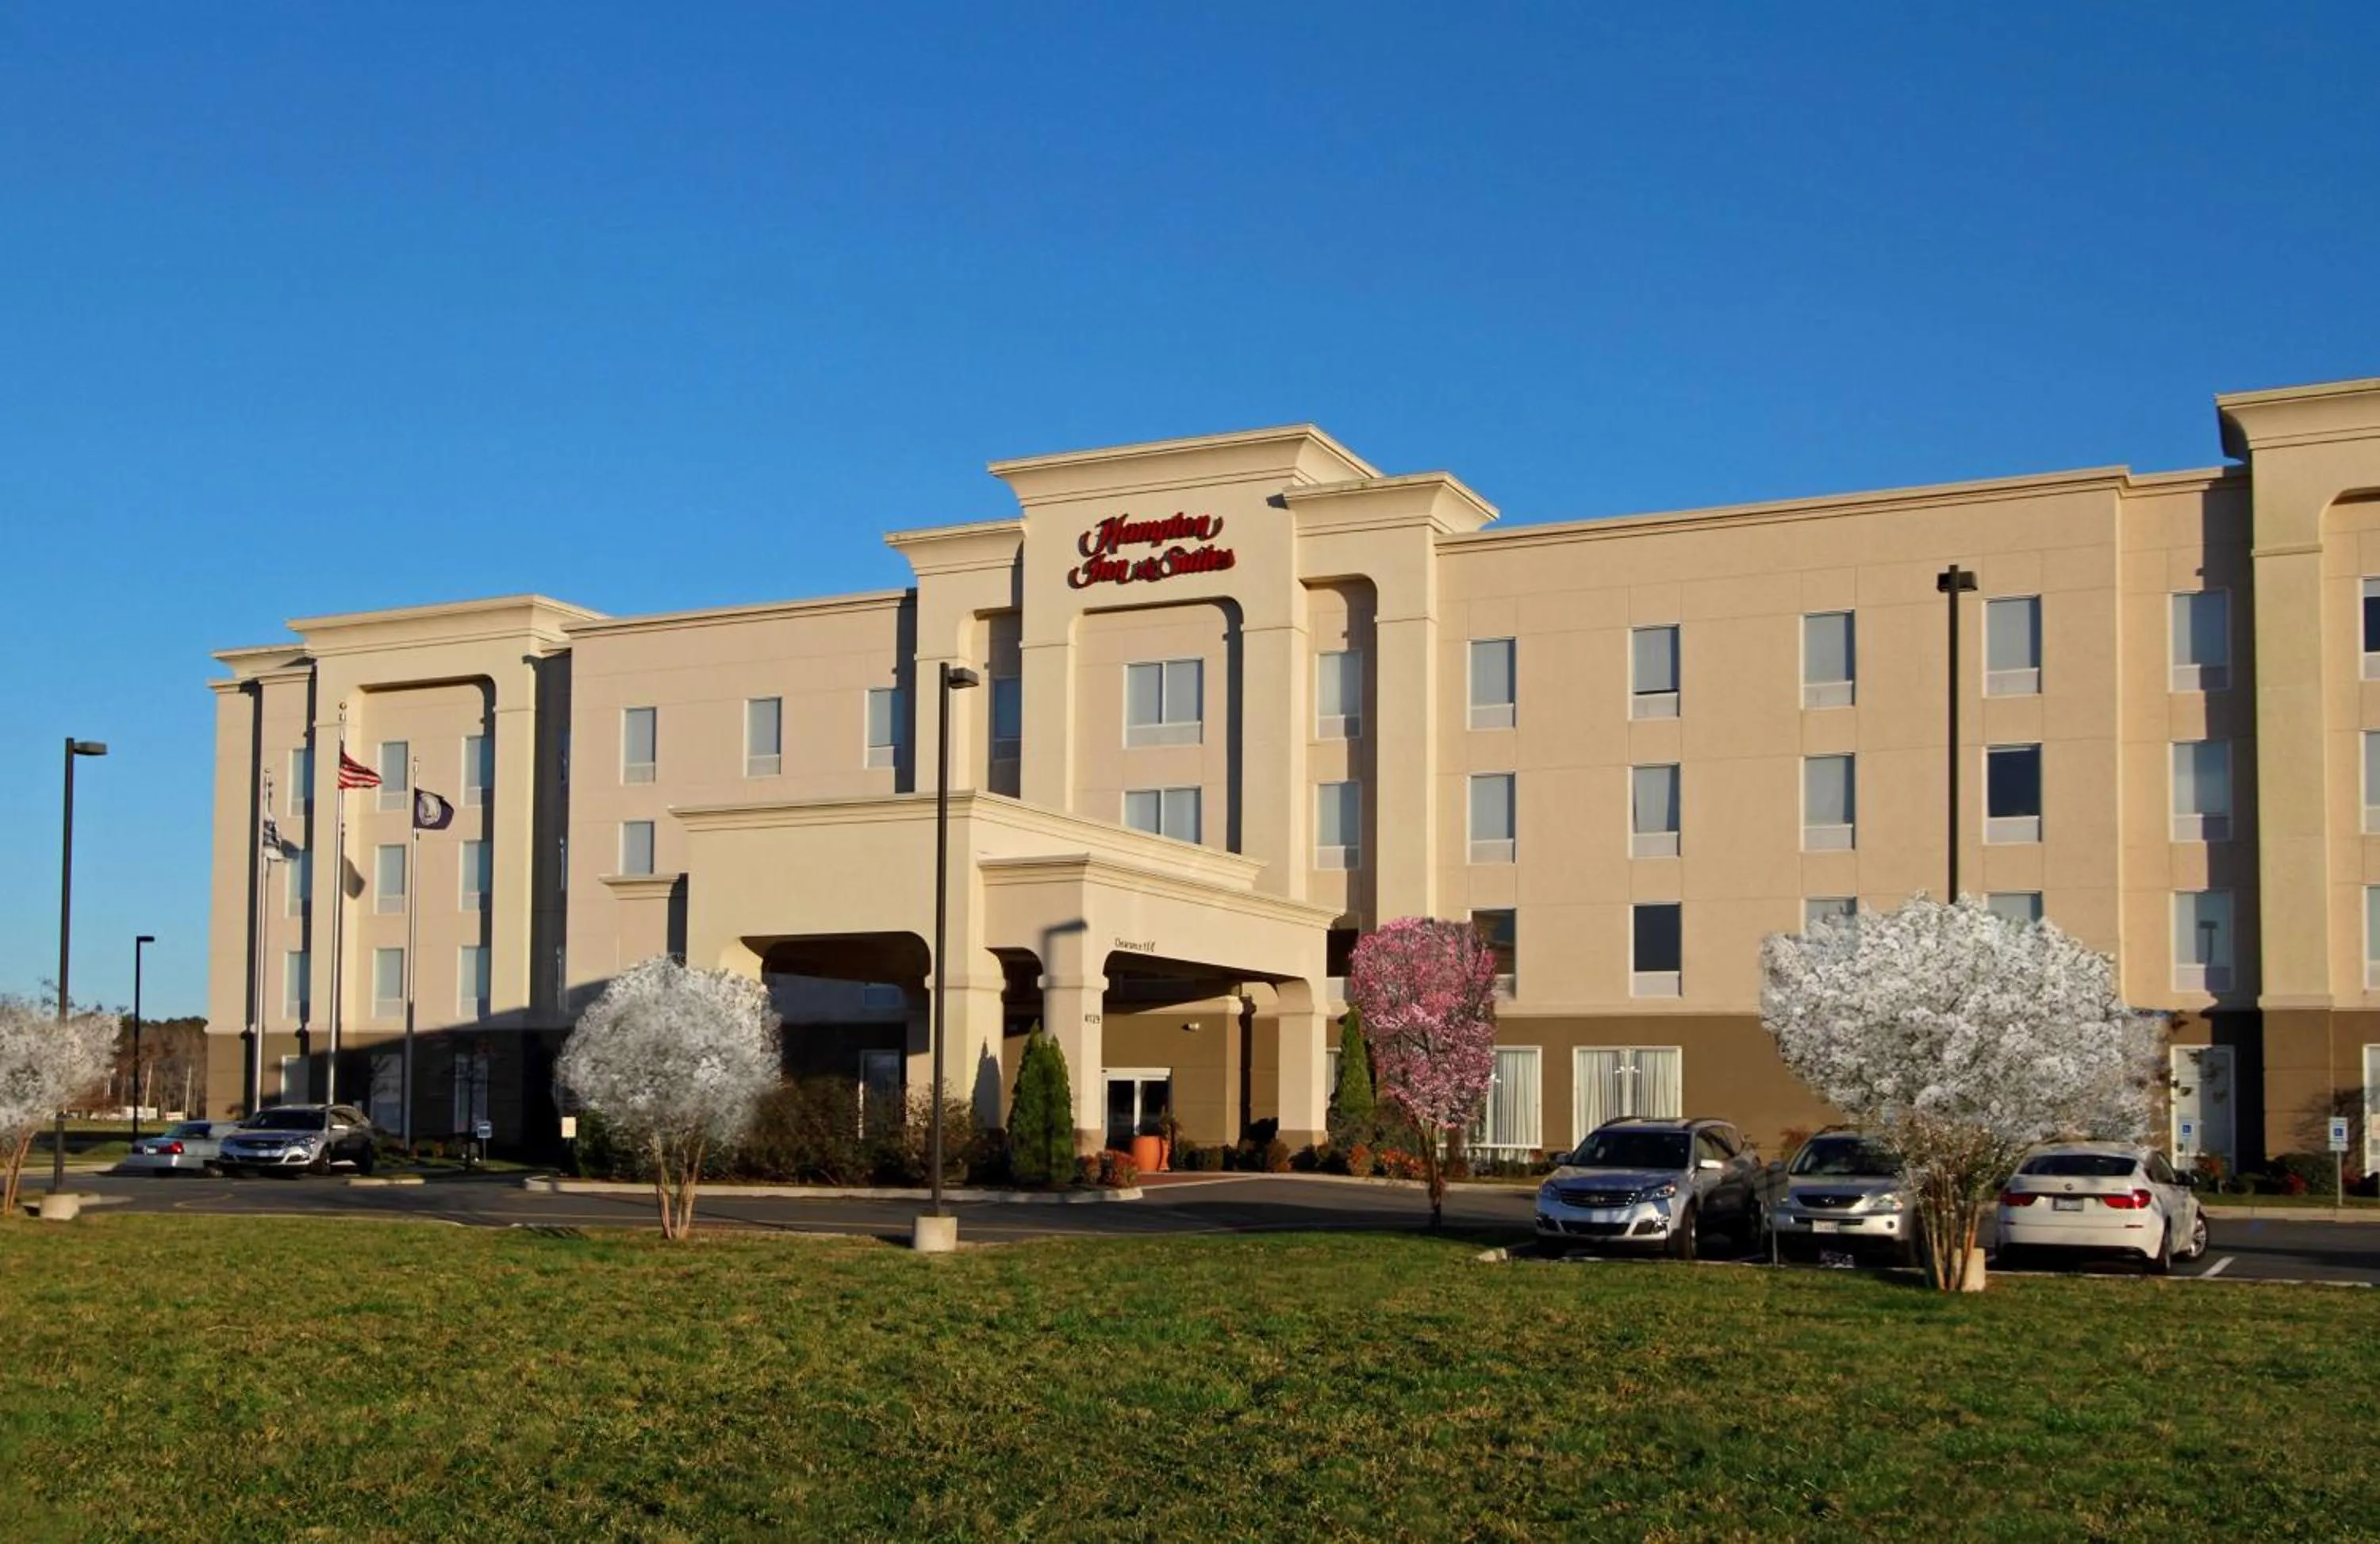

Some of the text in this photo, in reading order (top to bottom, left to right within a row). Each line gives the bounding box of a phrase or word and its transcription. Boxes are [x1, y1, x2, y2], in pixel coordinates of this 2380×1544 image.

[1078, 512, 1224, 557] Hampton
[1068, 553, 1134, 590] Inn
[1160, 544, 1236, 578] Suites
